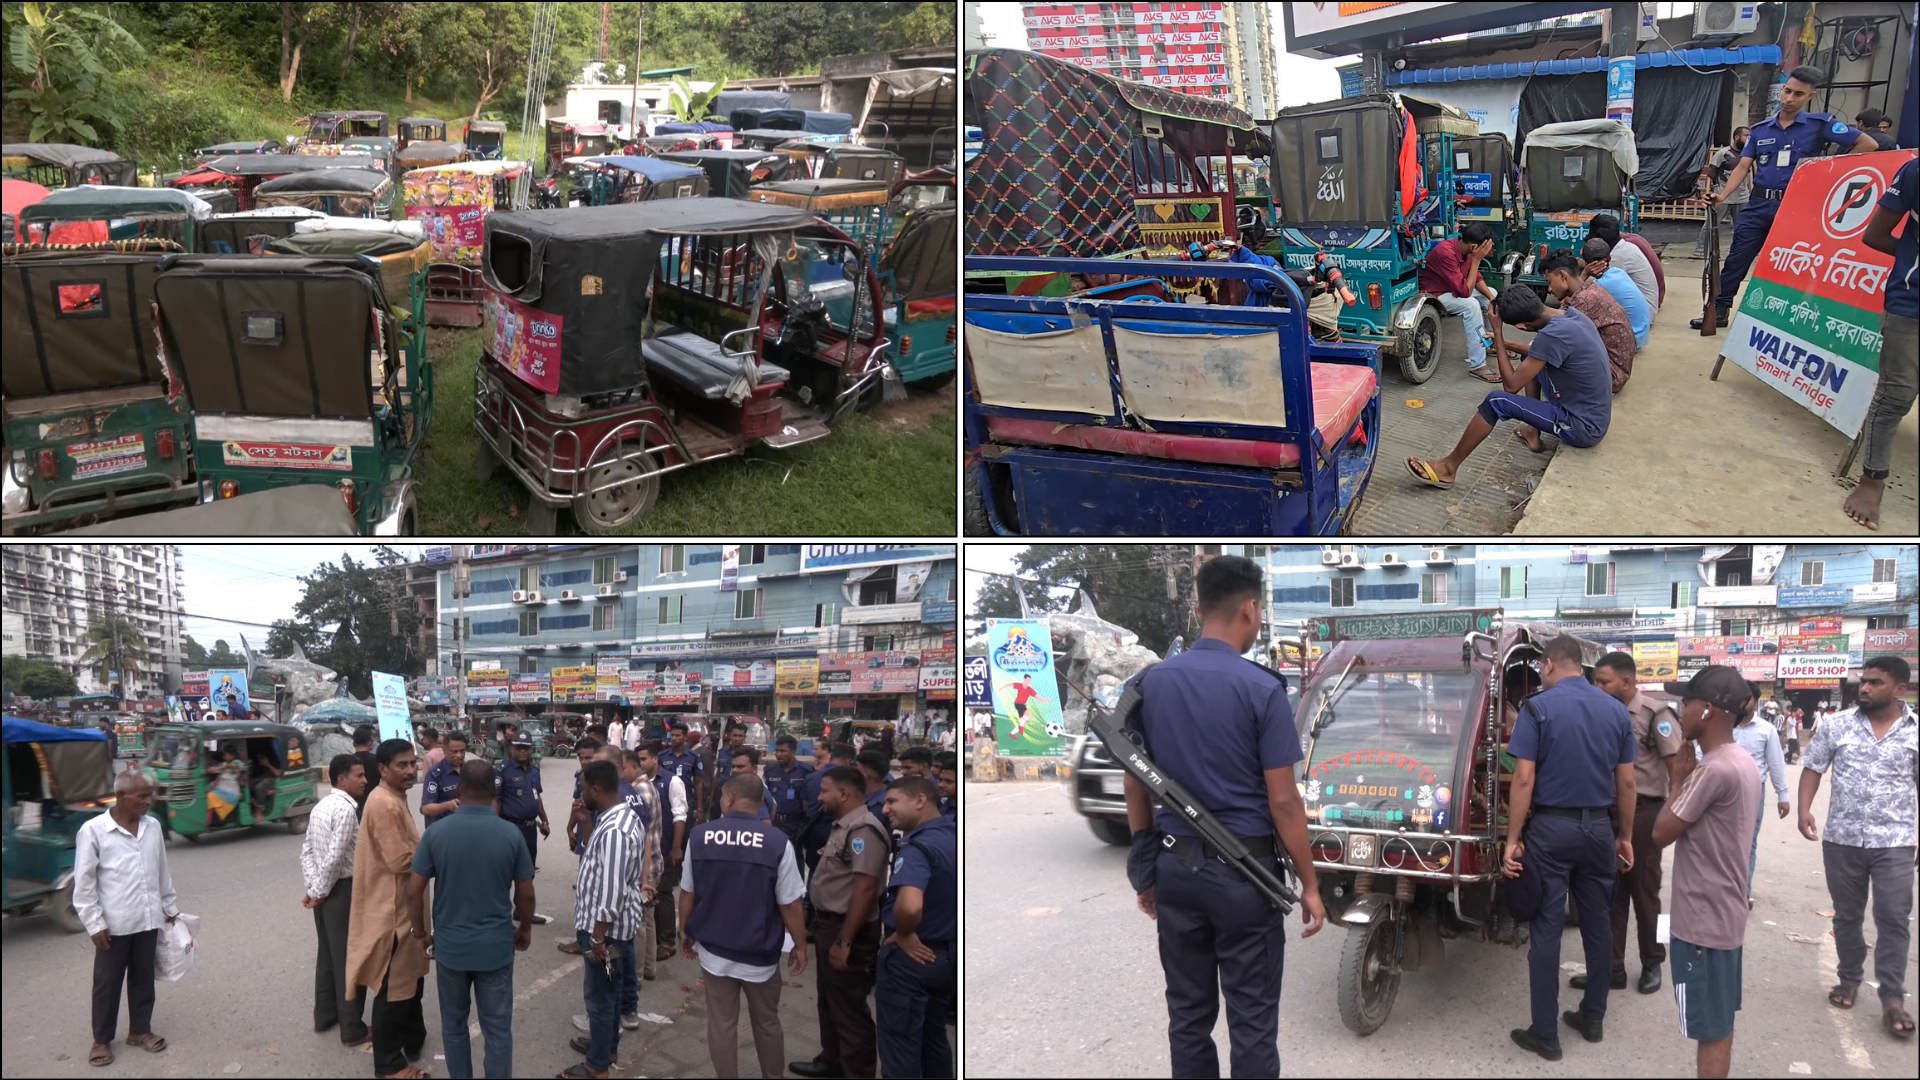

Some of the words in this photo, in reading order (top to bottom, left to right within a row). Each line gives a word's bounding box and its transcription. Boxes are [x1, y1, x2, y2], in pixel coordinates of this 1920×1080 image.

[1041, 16, 1060, 24] AKS
[1066, 16, 1085, 24] AKS
[1143, 12, 1164, 22] AKS
[1170, 12, 1190, 20] AKS
[1196, 11, 1216, 20] AKS
[1044, 38, 1064, 46] AKS
[1069, 37, 1089, 45] AKS
[1146, 34, 1166, 42] AKS
[1172, 34, 1192, 42] AKS
[1198, 32, 1218, 40] AKS
[1073, 58, 1092, 66] AKS
[1174, 54, 1194, 62] AKS
[1201, 54, 1221, 62] AKS
[1152, 76, 1172, 84] AKS
[1178, 75, 1198, 84] AKS
[1769, 241, 1823, 279] পার্কিং
[1764, 295, 1786, 316] জেলা
[1748, 326, 1849, 394] WALTON
[1756, 355, 1791, 383] Smart
[1792, 376, 1834, 409] Fridge
[248, 446, 278, 460] সেতু
[1868, 630, 1910, 647] শ্যামলী
[1800, 656, 1846, 665] Greenvalley
[1781, 666, 1815, 676] SUPER
[1817, 666, 1846, 675] SHOP
[704, 830, 764, 848] POLICE
